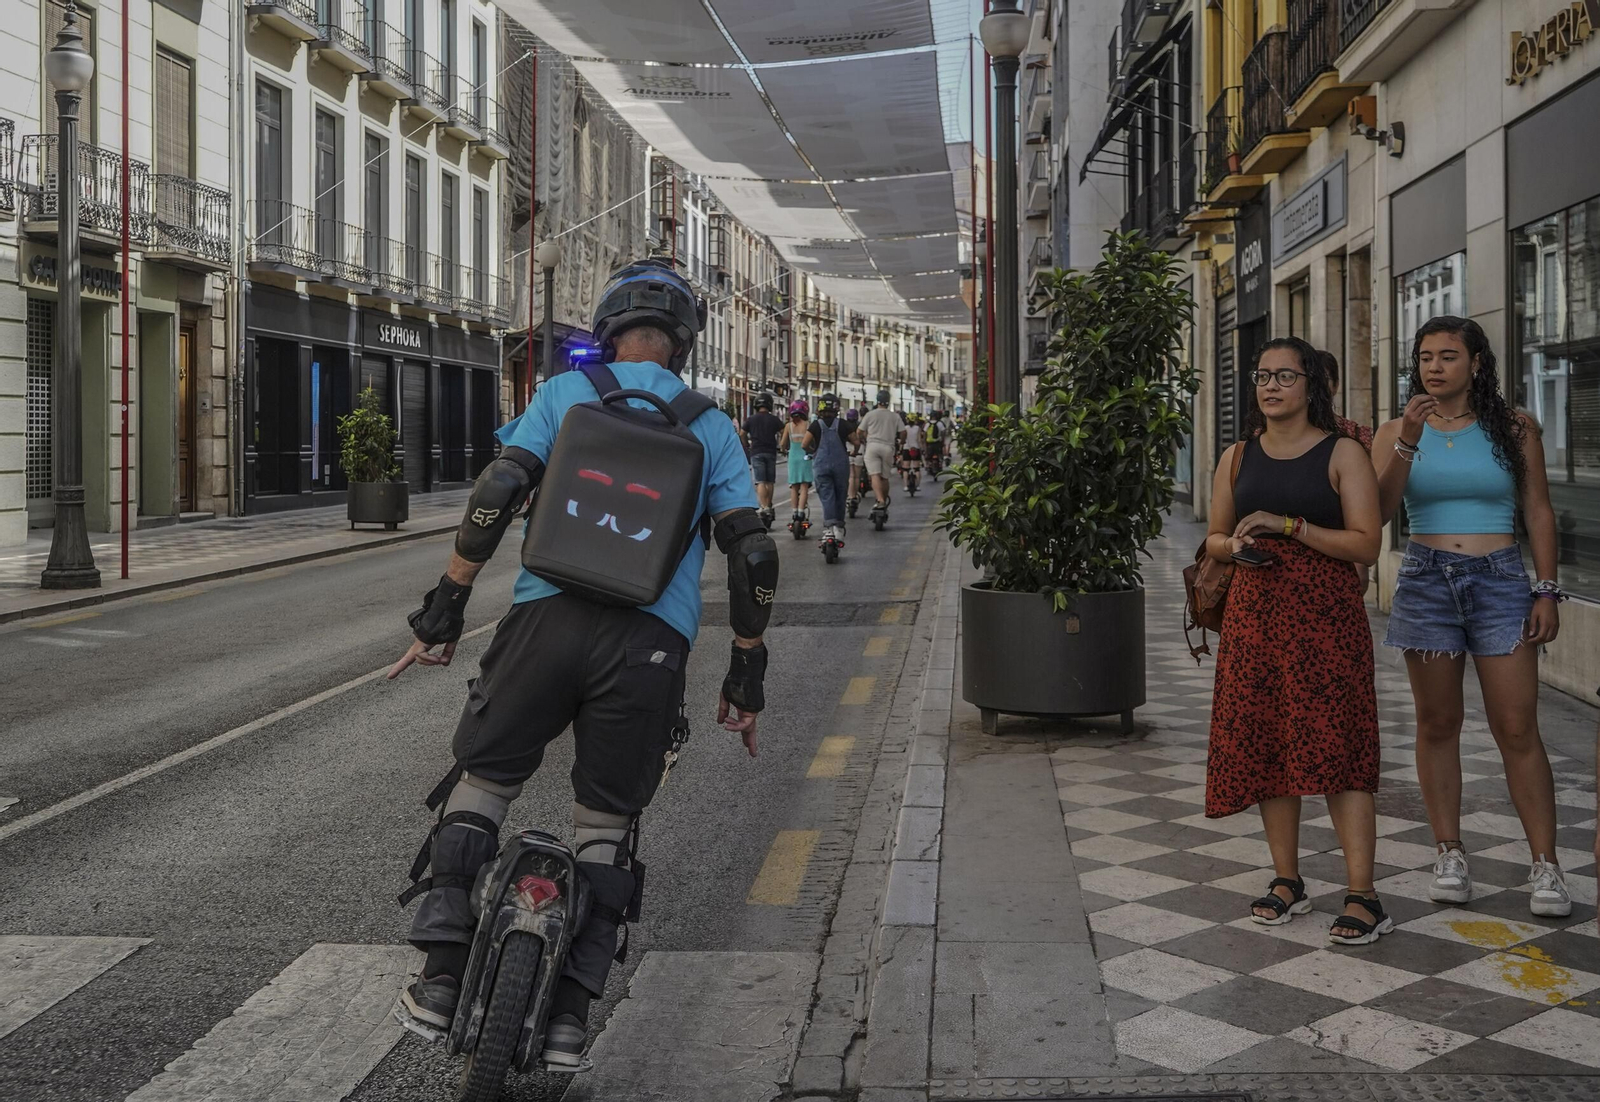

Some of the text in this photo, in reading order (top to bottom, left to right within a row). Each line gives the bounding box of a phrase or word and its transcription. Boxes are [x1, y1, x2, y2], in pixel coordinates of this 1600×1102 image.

[768, 30, 901, 45] Alhambra
[619, 87, 731, 97] Alhambra
[379, 323, 421, 348] SEPHORA
